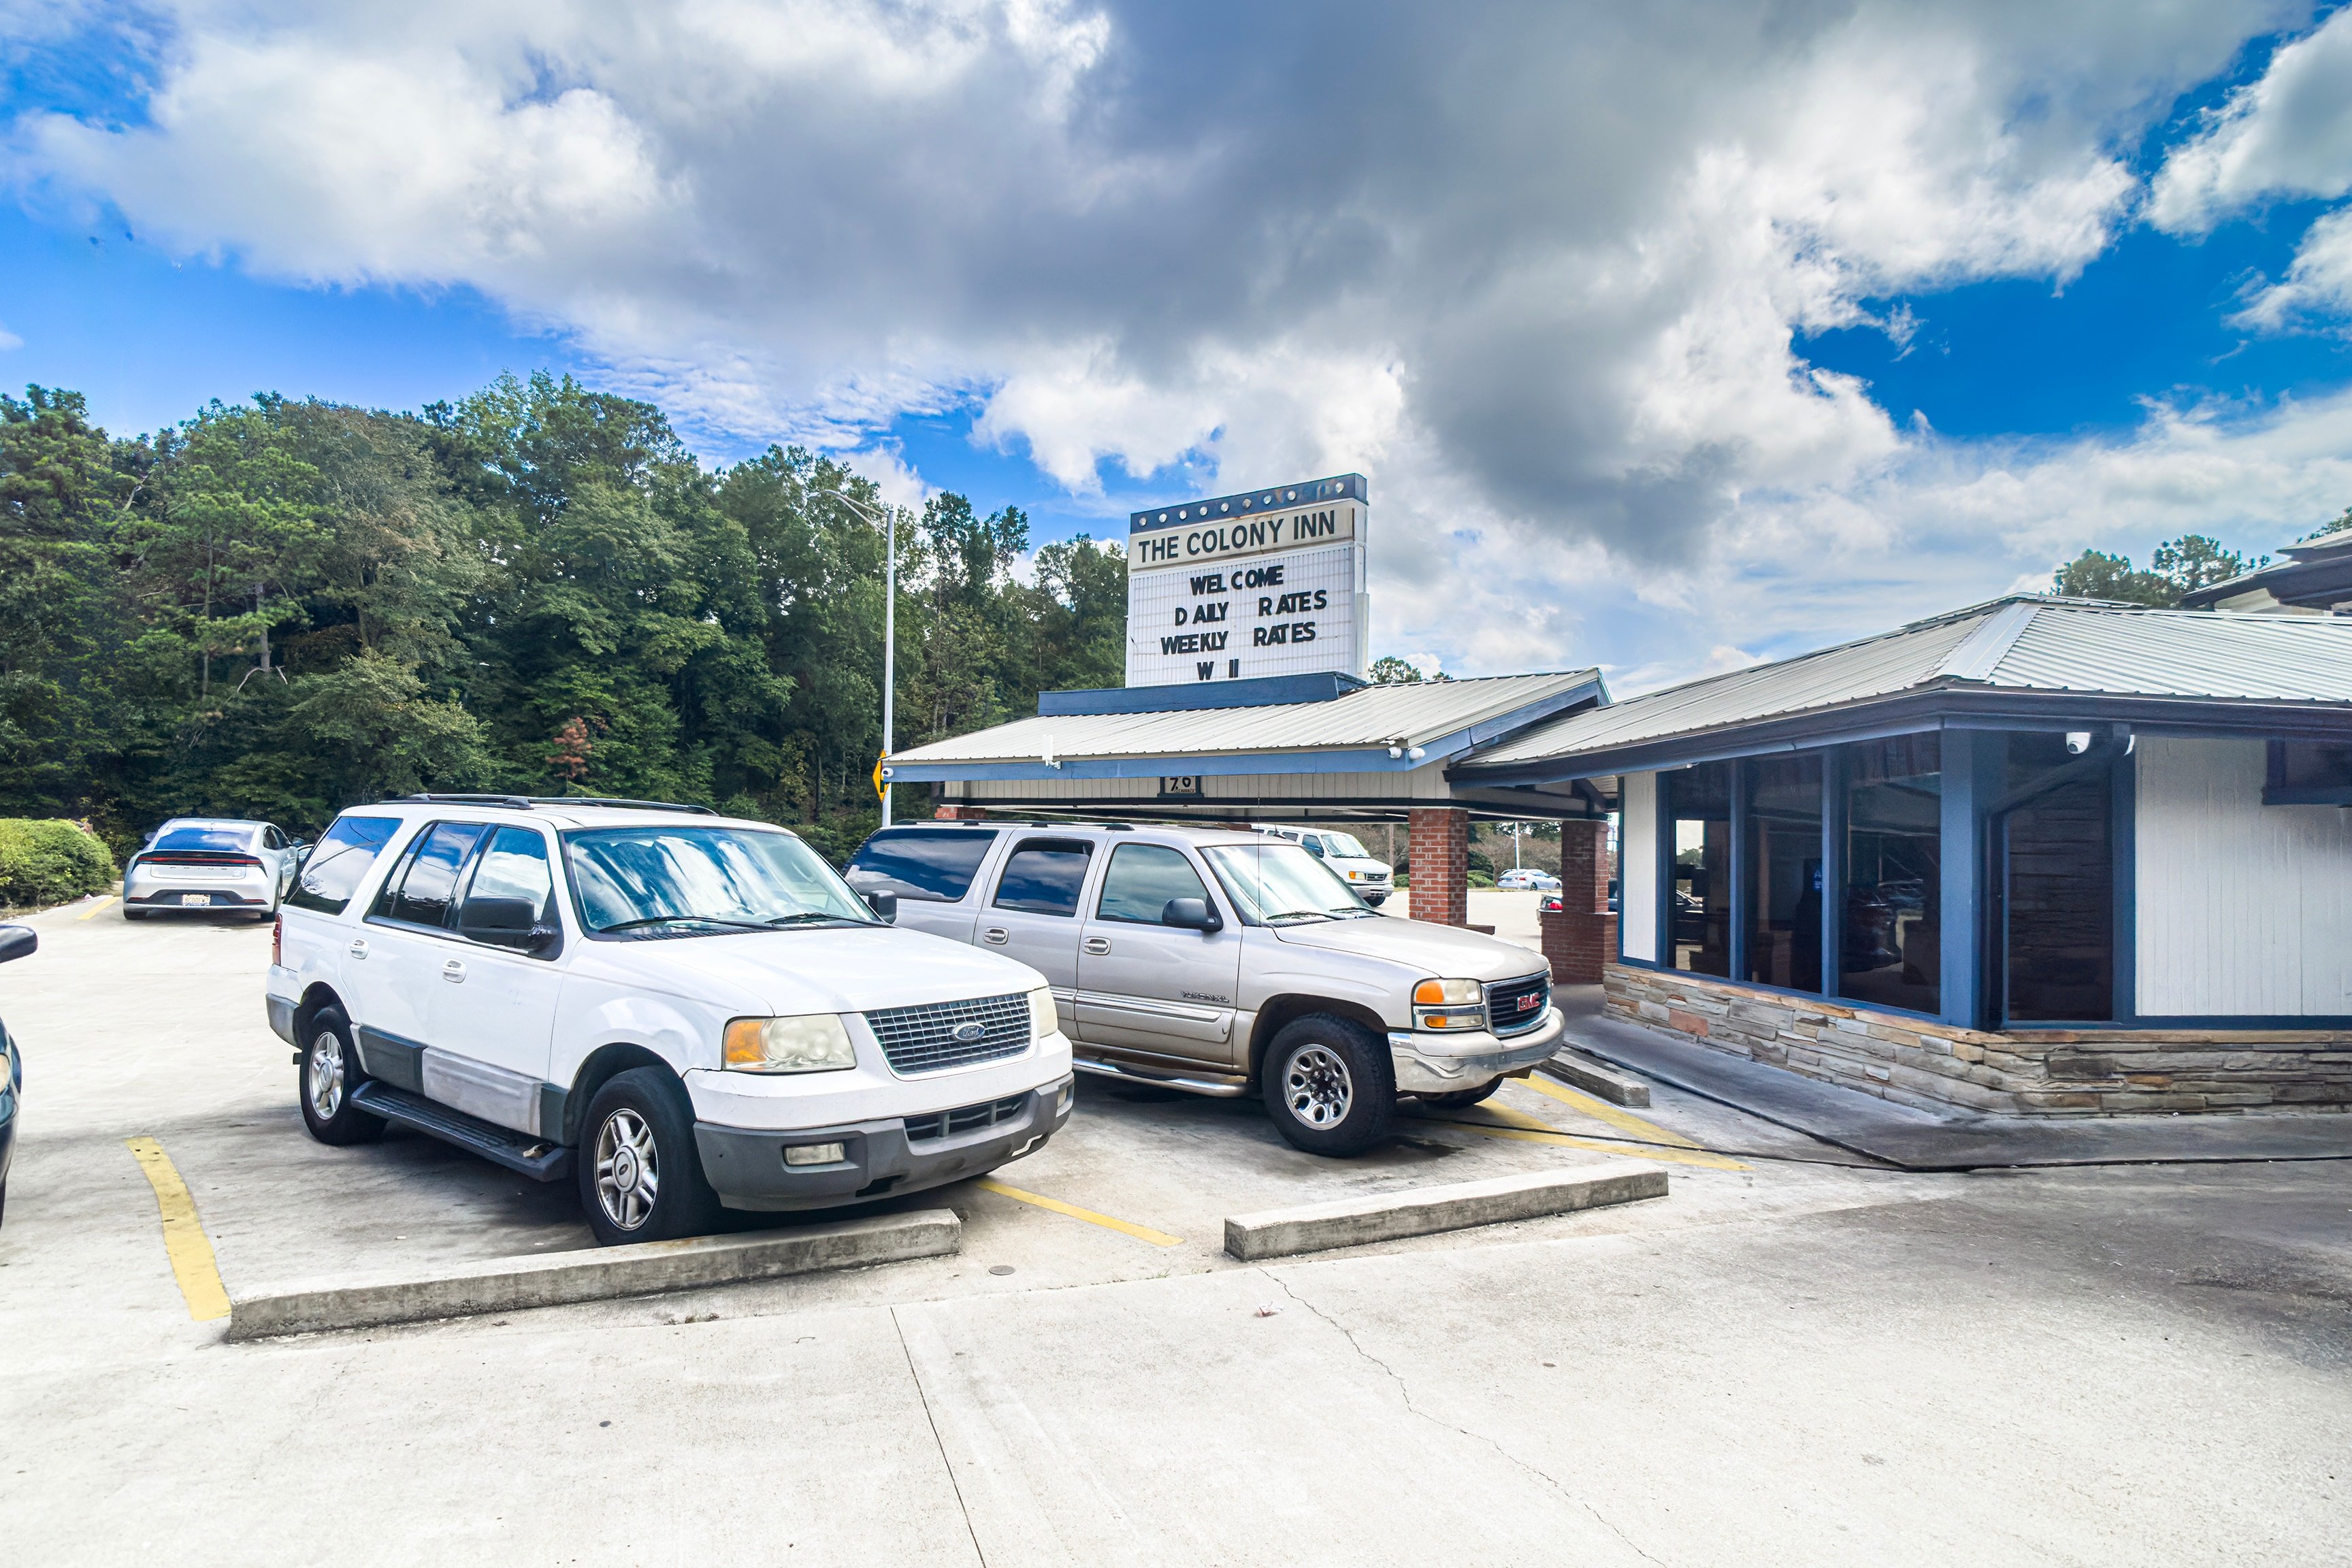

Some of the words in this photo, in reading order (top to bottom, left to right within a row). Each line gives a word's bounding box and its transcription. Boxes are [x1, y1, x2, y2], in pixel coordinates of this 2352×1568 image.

[1139, 536, 1179, 563] THE
[1187, 518, 1284, 555] COLONY
[1293, 510, 1335, 540] INN
[1190, 565, 1284, 595] WELCOME
[1175, 602, 1228, 626] DAILY
[1259, 590, 1326, 617] RATES
[1161, 631, 1228, 655] WEEKLY
[1254, 622, 1316, 647] RATES
[1517, 992, 1541, 1011] GMC
[962, 1026, 980, 1036] Ford
